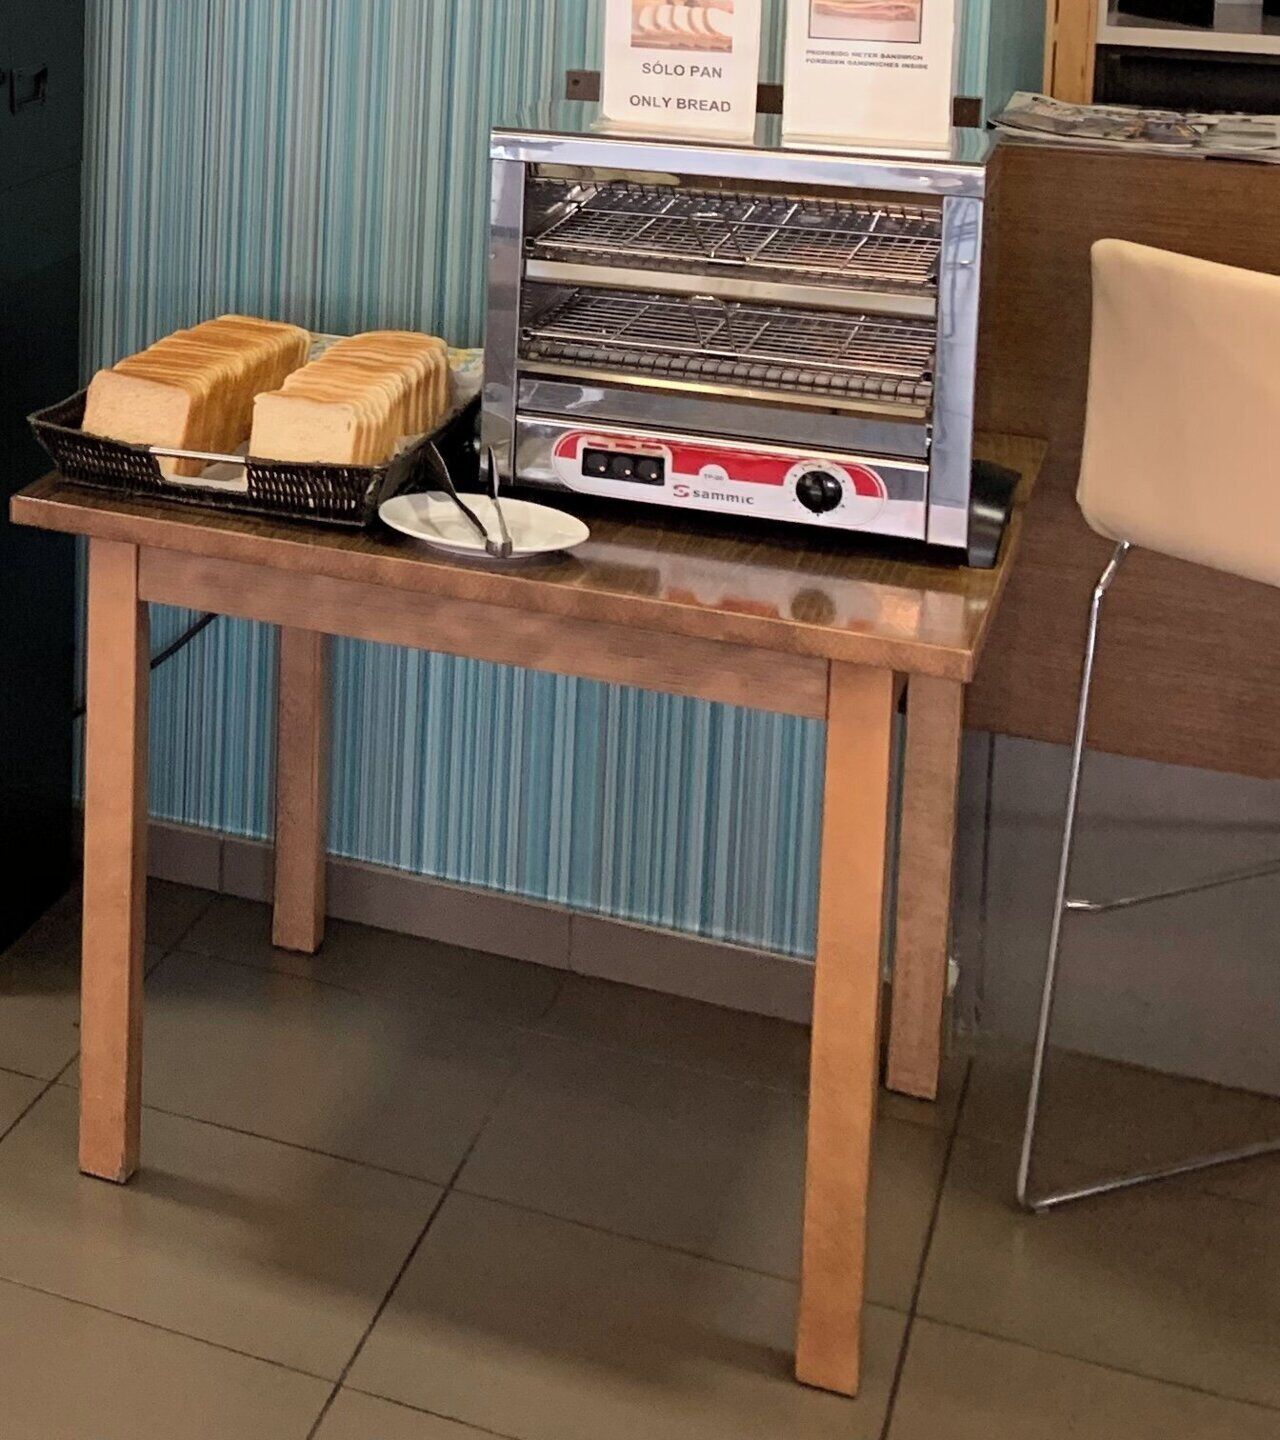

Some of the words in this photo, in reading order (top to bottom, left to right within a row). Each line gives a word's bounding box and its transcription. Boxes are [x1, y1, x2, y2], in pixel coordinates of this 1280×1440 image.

[642, 61, 685, 76] SÓLO
[690, 66, 722, 79] PAN
[629, 95, 671, 108] ONLY
[676, 98, 731, 113] BREAD
[693, 489, 755, 505] sammic
